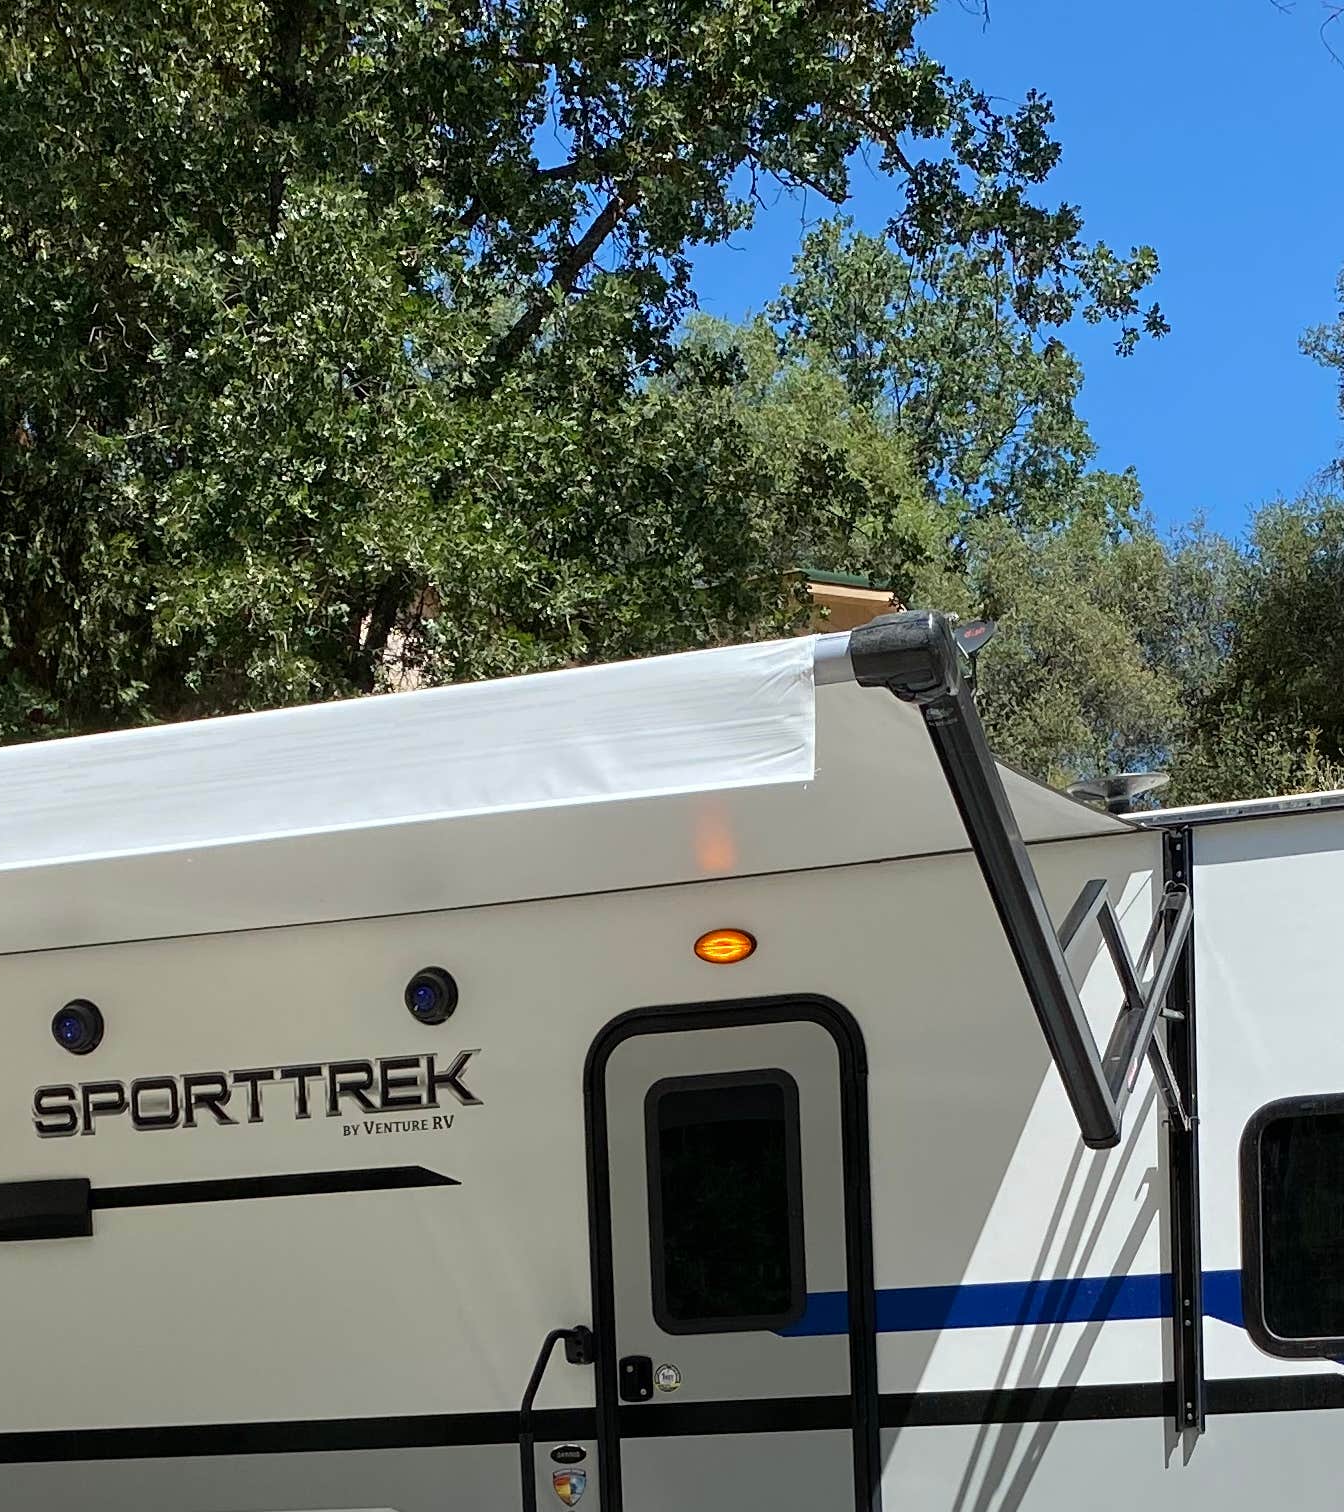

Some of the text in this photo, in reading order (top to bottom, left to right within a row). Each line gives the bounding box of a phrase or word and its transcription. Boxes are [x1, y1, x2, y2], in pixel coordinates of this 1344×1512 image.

[31, 1048, 483, 1138] SPORTTREK
[342, 1115, 455, 1137] BY VENTURE RV
